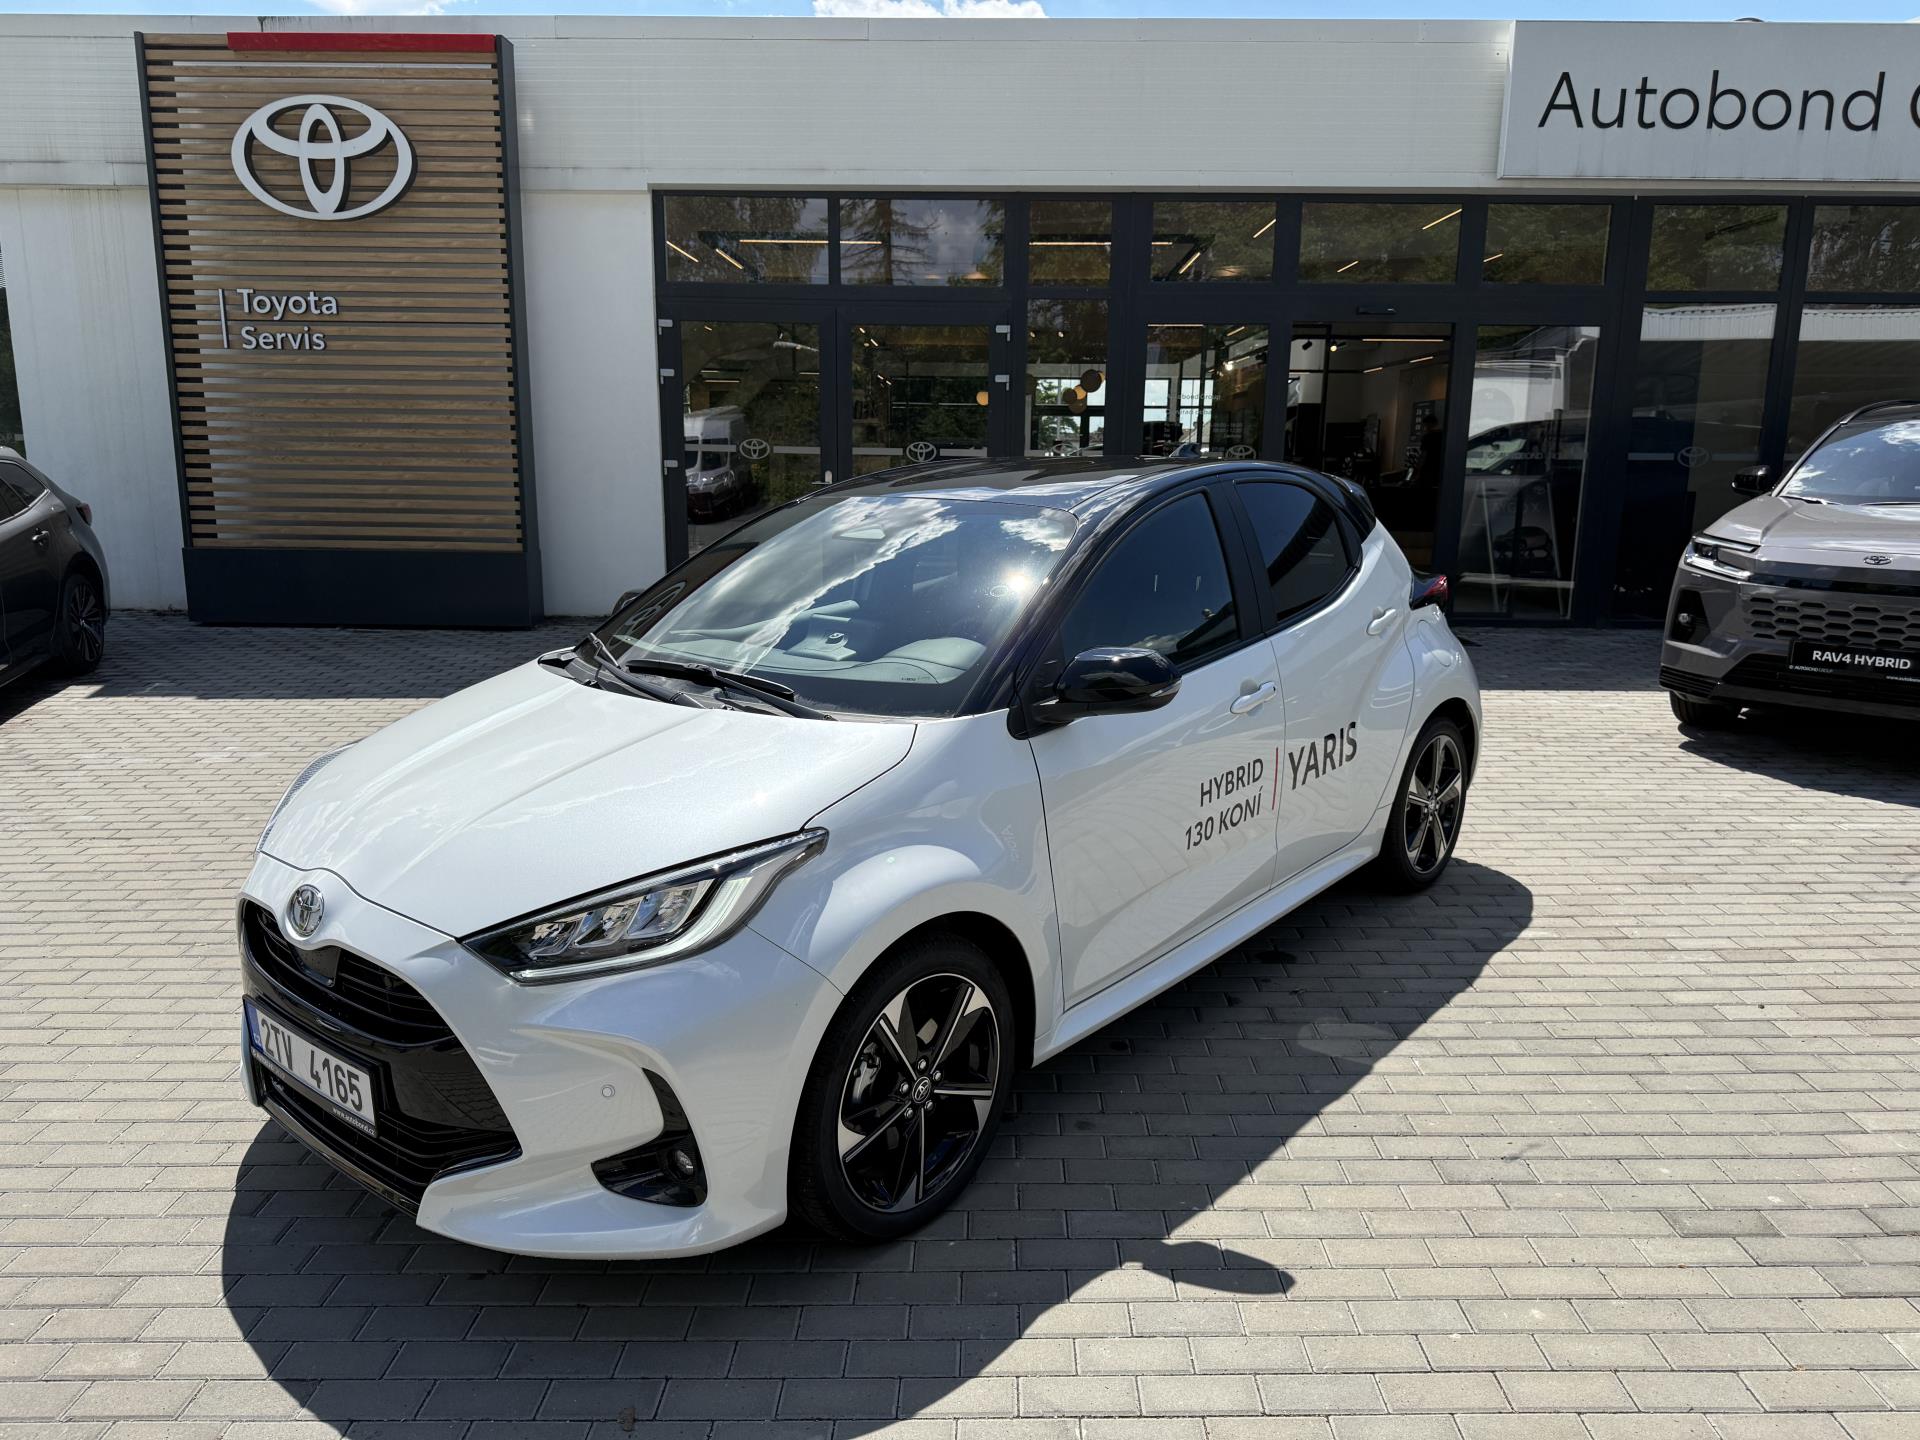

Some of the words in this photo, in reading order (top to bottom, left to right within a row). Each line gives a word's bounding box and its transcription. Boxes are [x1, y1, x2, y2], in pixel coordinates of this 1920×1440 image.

[1538, 69, 1886, 131] Autobond
[236, 288, 338, 320] Toyota
[240, 326, 326, 350] Servis
[1812, 650, 1852, 664] RAV4
[1854, 654, 1911, 670] HYBRID
[1200, 758, 1264, 807] HYBRID
[1288, 721, 1358, 790] YARIS
[1185, 816, 1214, 850] 130
[1218, 785, 1264, 834] KONÍ
[261, 1018, 293, 1071] 2TV
[310, 1050, 363, 1112] 4165
